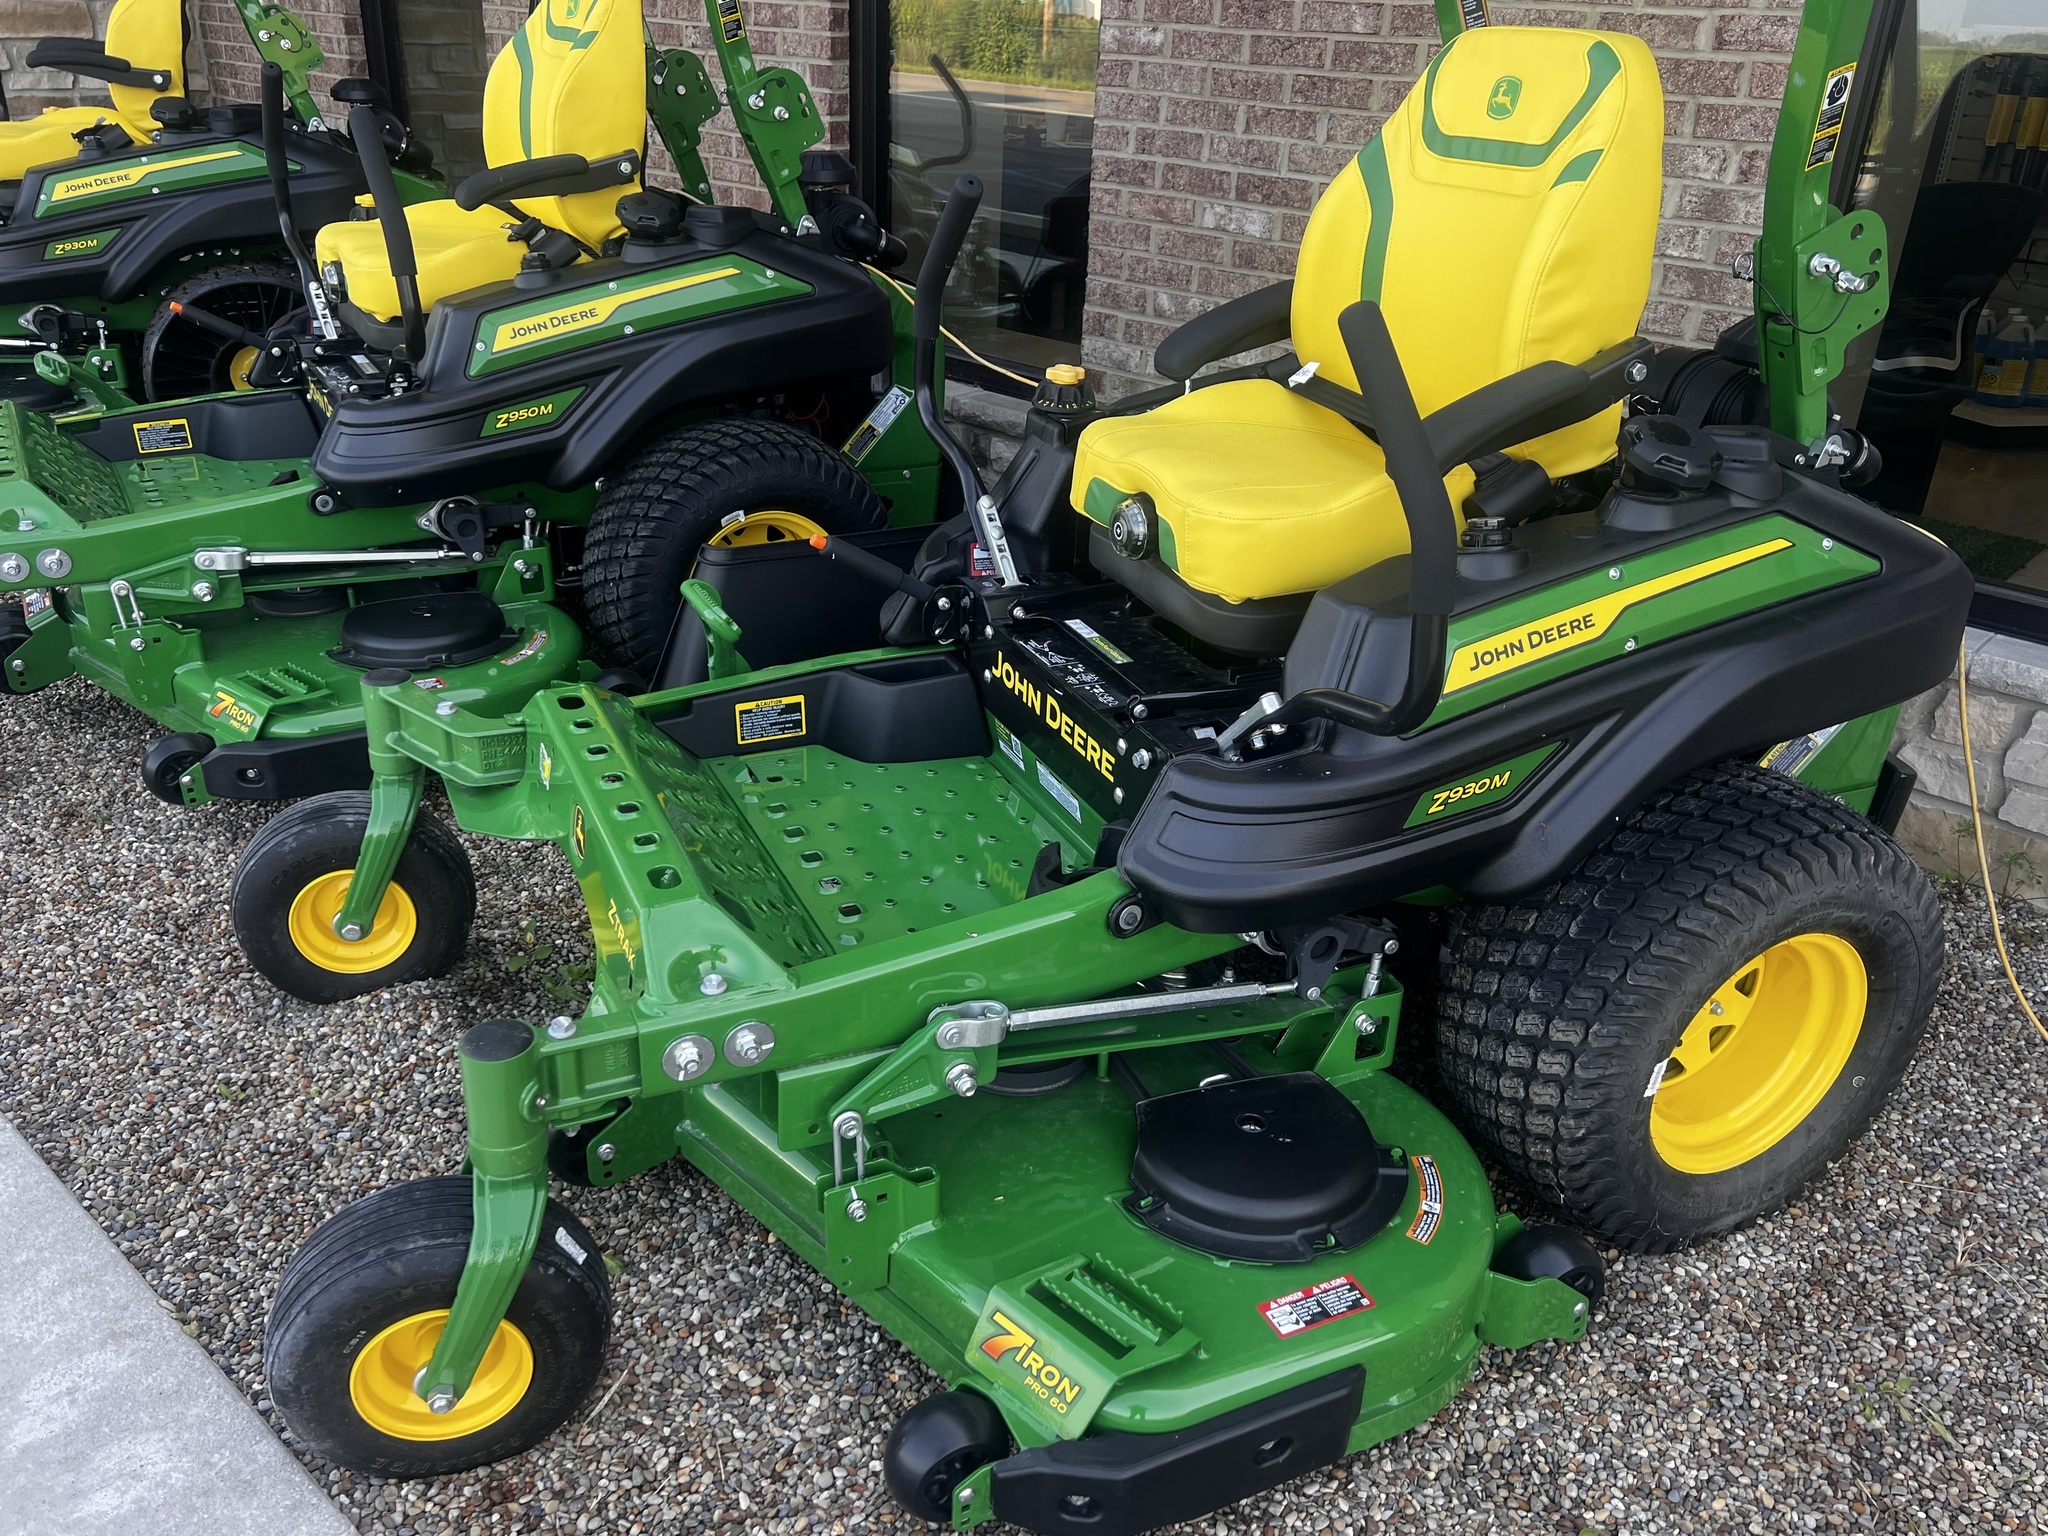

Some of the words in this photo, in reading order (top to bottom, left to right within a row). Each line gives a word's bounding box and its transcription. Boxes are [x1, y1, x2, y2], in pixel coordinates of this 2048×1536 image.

[64, 181, 93, 193] JOHN
[94, 173, 131, 187] DEERE
[54, 239, 98, 255] Z930M
[510, 320, 549, 340] JOHN
[549, 307, 599, 328] DEERE
[495, 403, 553, 429] Z950M
[1469, 638, 1525, 672] JOHN
[1526, 612, 1596, 650] DEERE
[760, 699, 783, 707] CAUTION
[991, 650, 1042, 716] JOHN
[1045, 693, 1116, 783] DEERE
[1427, 769, 1512, 815] Z930M
[1277, 1291, 1305, 1306] DANGER
[1318, 1276, 1348, 1291] PELIGRO
[1023, 1376, 1049, 1399] PRO
[1049, 1396, 1068, 1414] 60
